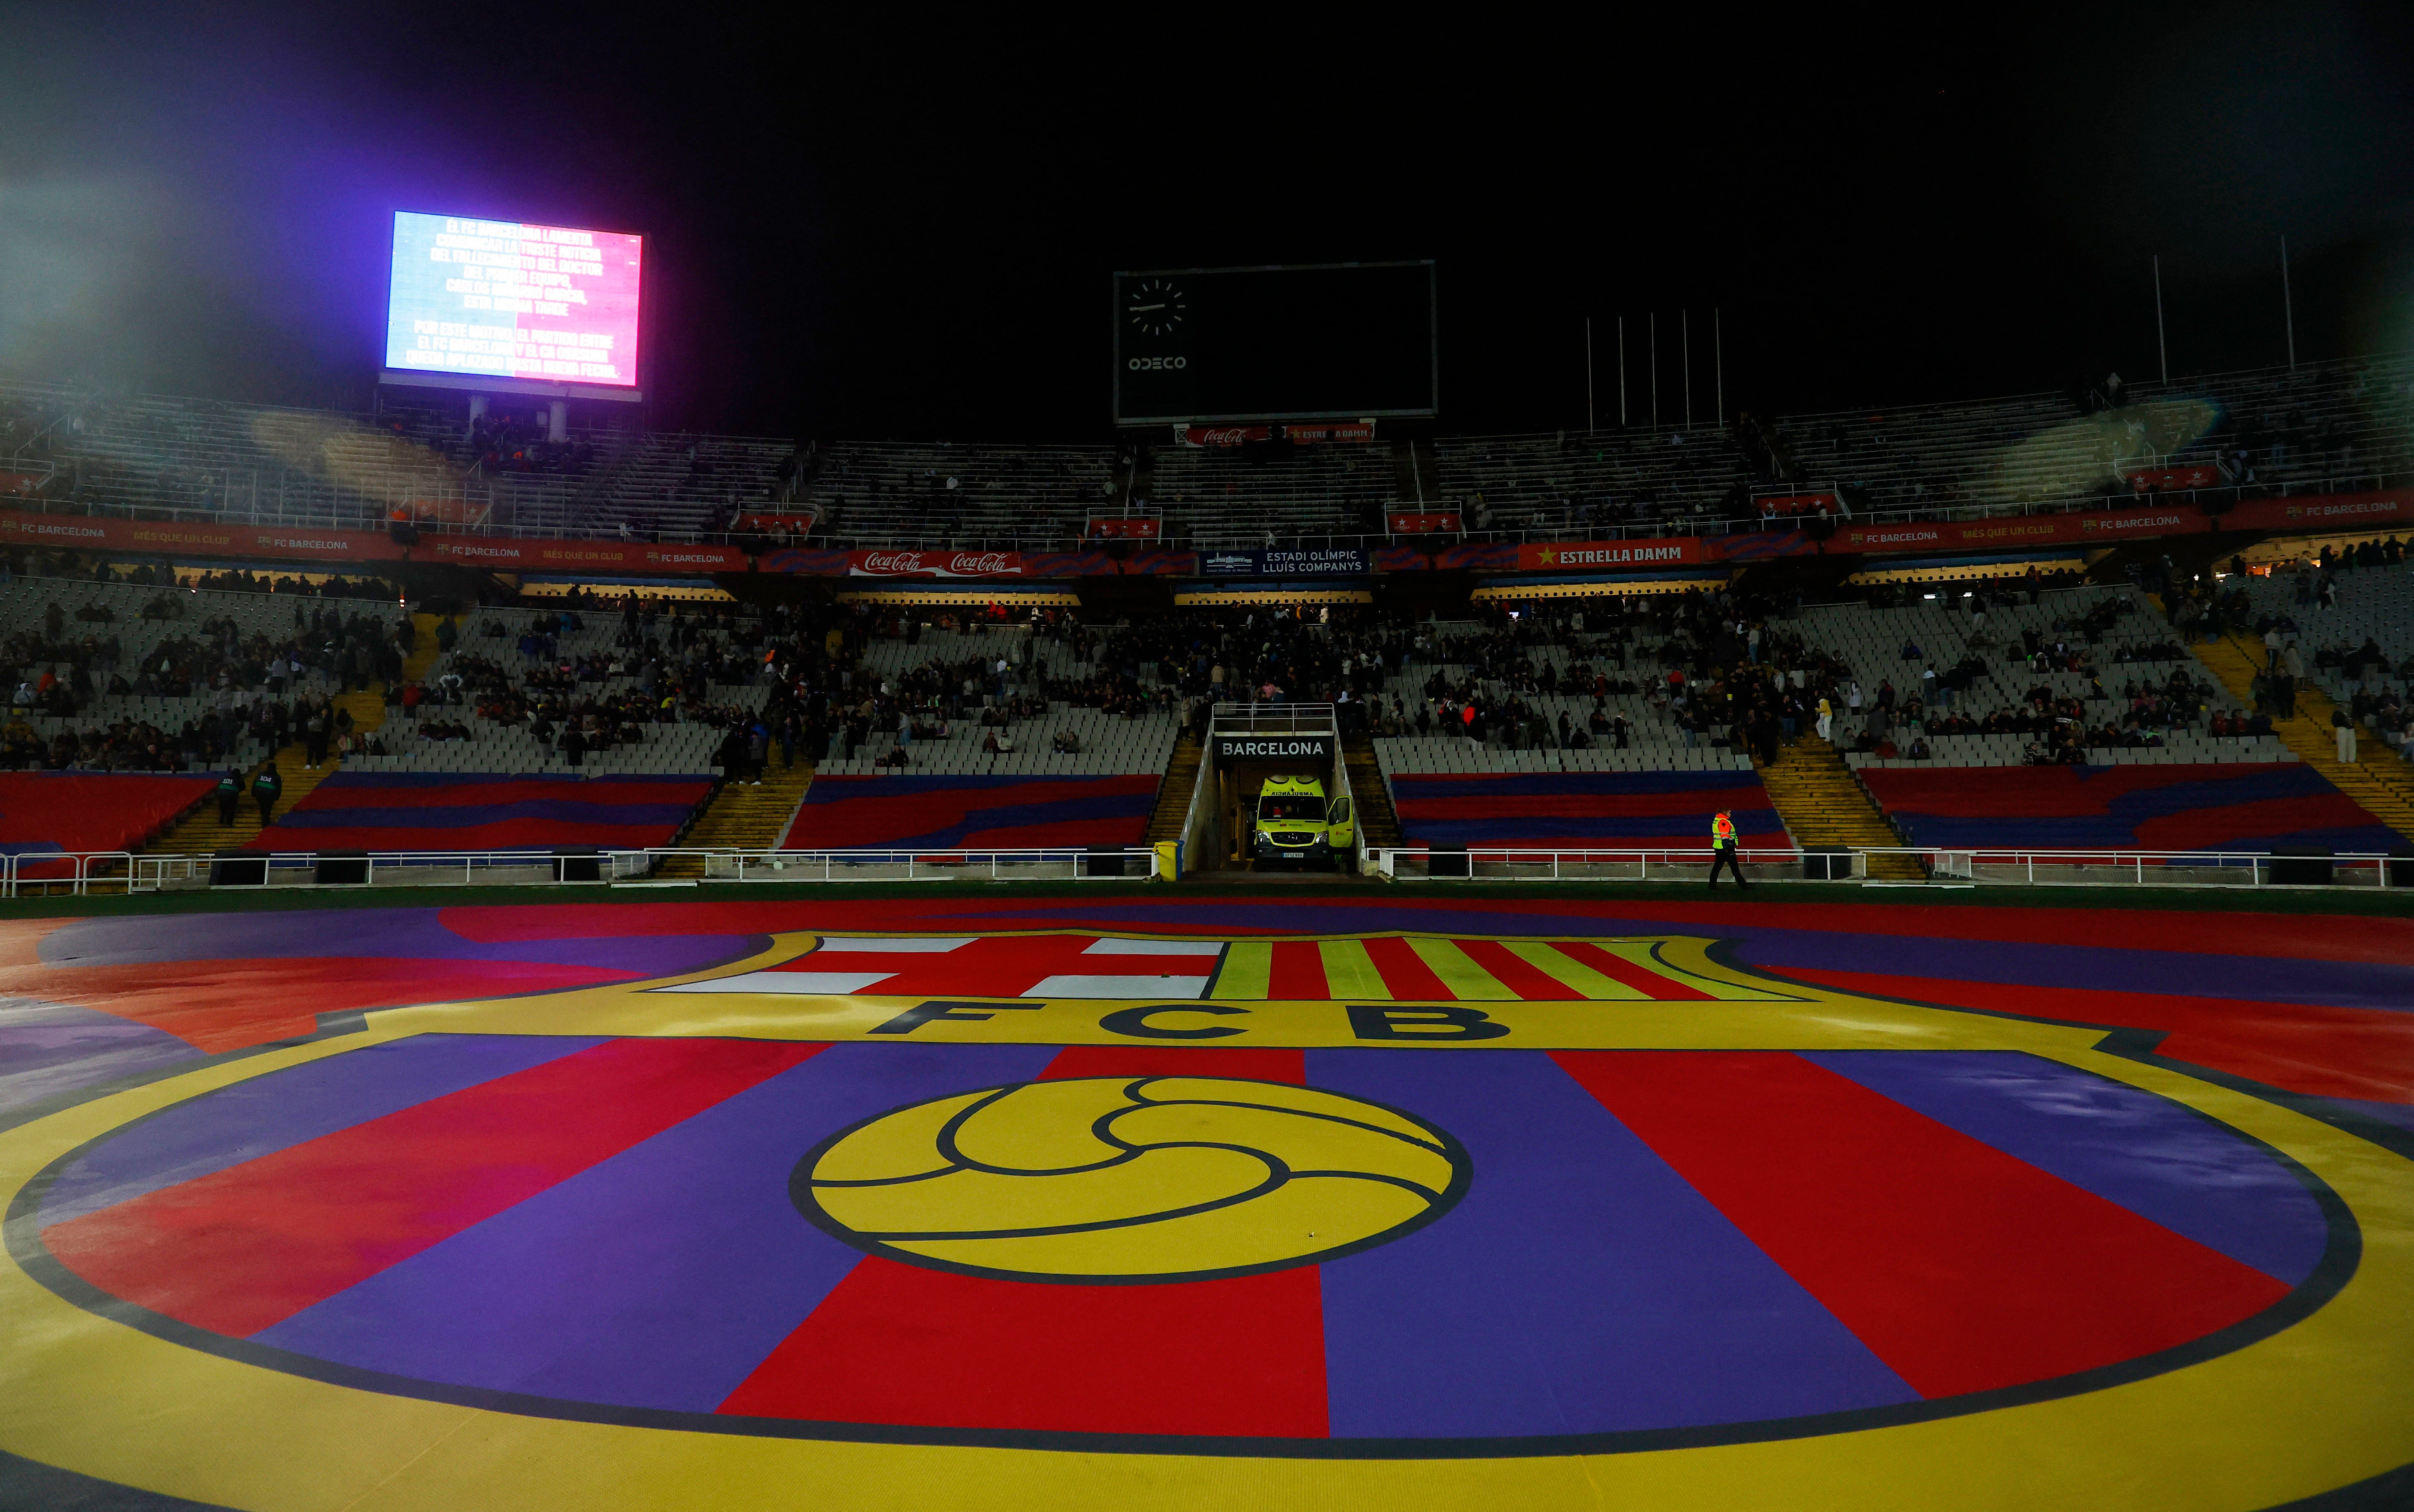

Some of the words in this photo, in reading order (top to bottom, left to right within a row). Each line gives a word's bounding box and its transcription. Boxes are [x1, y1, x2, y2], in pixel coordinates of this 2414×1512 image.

[446, 219, 459, 233] EL
[461, 221, 476, 234] FC
[477, 222, 541, 241] BARCELONA
[543, 229, 592, 246] LAMENTA
[504, 240, 518, 253] LA
[520, 241, 557, 258] TRISTE
[559, 245, 601, 261] NOTICIA
[431, 247, 451, 262] DEL
[538, 258, 557, 272] DEL
[559, 260, 603, 276] DOCTOR
[464, 265, 483, 280] DEL
[415, 320, 438, 335] POR
[440, 322, 467, 338] ESTE
[517, 329, 530, 343] EL
[579, 333, 613, 349] ENTRE
[418, 335, 431, 350] EL
[433, 337, 448, 350] FC
[516, 343, 524, 356] Y
[525, 344, 538, 358] EL
[1129, 357, 1186, 370] ODECO
[2307, 507, 2321, 516] FC
[2324, 502, 2397, 515] BARCELONA
[2101, 521, 2113, 529] FC
[2116, 516, 2180, 528] BARCELONA
[22, 524, 35, 533] FC
[38, 526, 104, 537] BARCELONA
[1881, 532, 1938, 542] BARCELONA
[1963, 528, 1984, 538] MÉS
[1987, 529, 2007, 537] QUE
[2027, 525, 2054, 534] CLUB
[160, 533, 182, 542] QUE
[184, 534, 200, 543] UN
[202, 534, 229, 544] CLUB
[289, 539, 348, 549] BARCELONA
[465, 547, 520, 557] BARCELONA
[543, 549, 563, 559] MÉS
[564, 551, 582, 559] QUE
[674, 554, 724, 563] BARCELONA
[1267, 552, 1306, 561] ESTADI
[1310, 549, 1357, 561] OLÍMPIC
[1560, 549, 1631, 564] ESTRELLA
[1634, 547, 1681, 561] DAMM
[865, 552, 926, 571] Coca-Cola
[951, 553, 1011, 572] Coca-Cola
[1263, 561, 1295, 573] LLUÍS
[1298, 561, 1362, 572] COMPANYS
[1222, 742, 1324, 755] BARCELONA
